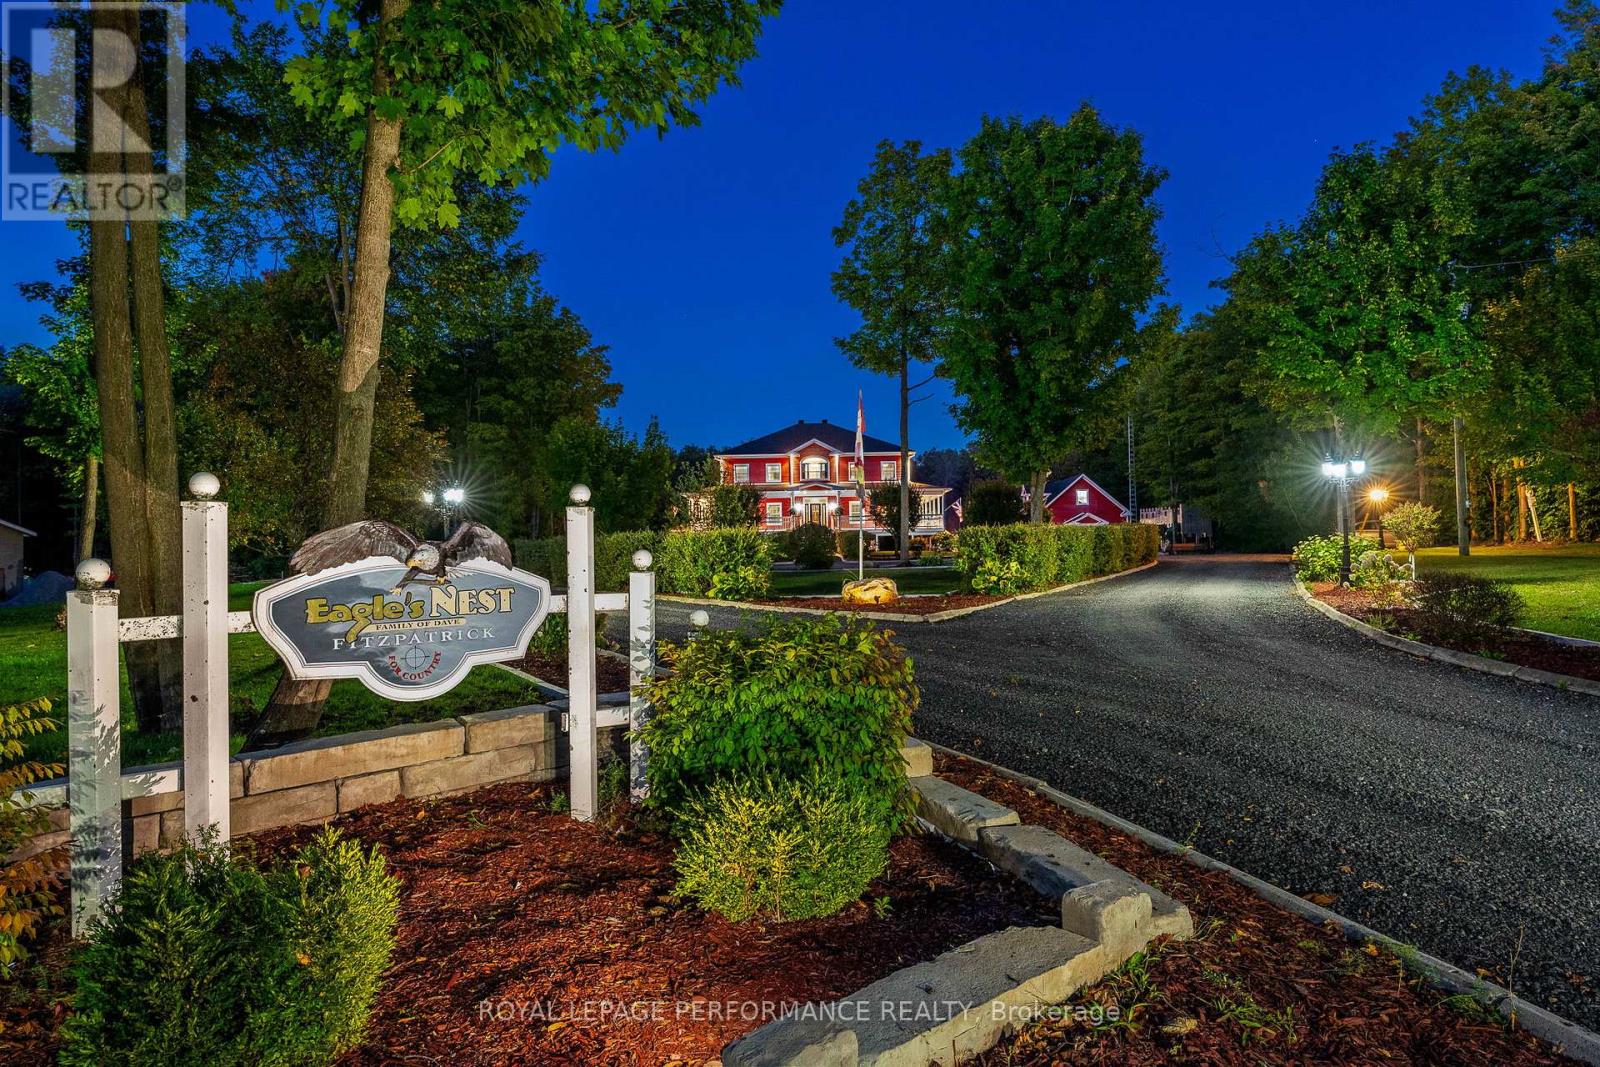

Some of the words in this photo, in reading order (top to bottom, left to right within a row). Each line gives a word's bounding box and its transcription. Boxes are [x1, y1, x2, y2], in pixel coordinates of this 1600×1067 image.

[305, 591, 425, 644] Eagle's
[429, 585, 515, 617] NEST
[434, 618, 460, 626] DAVE
[333, 627, 495, 650] FITZPATRICK
[388, 656, 401, 675] FOR
[403, 651, 441, 680] COUNTRY
